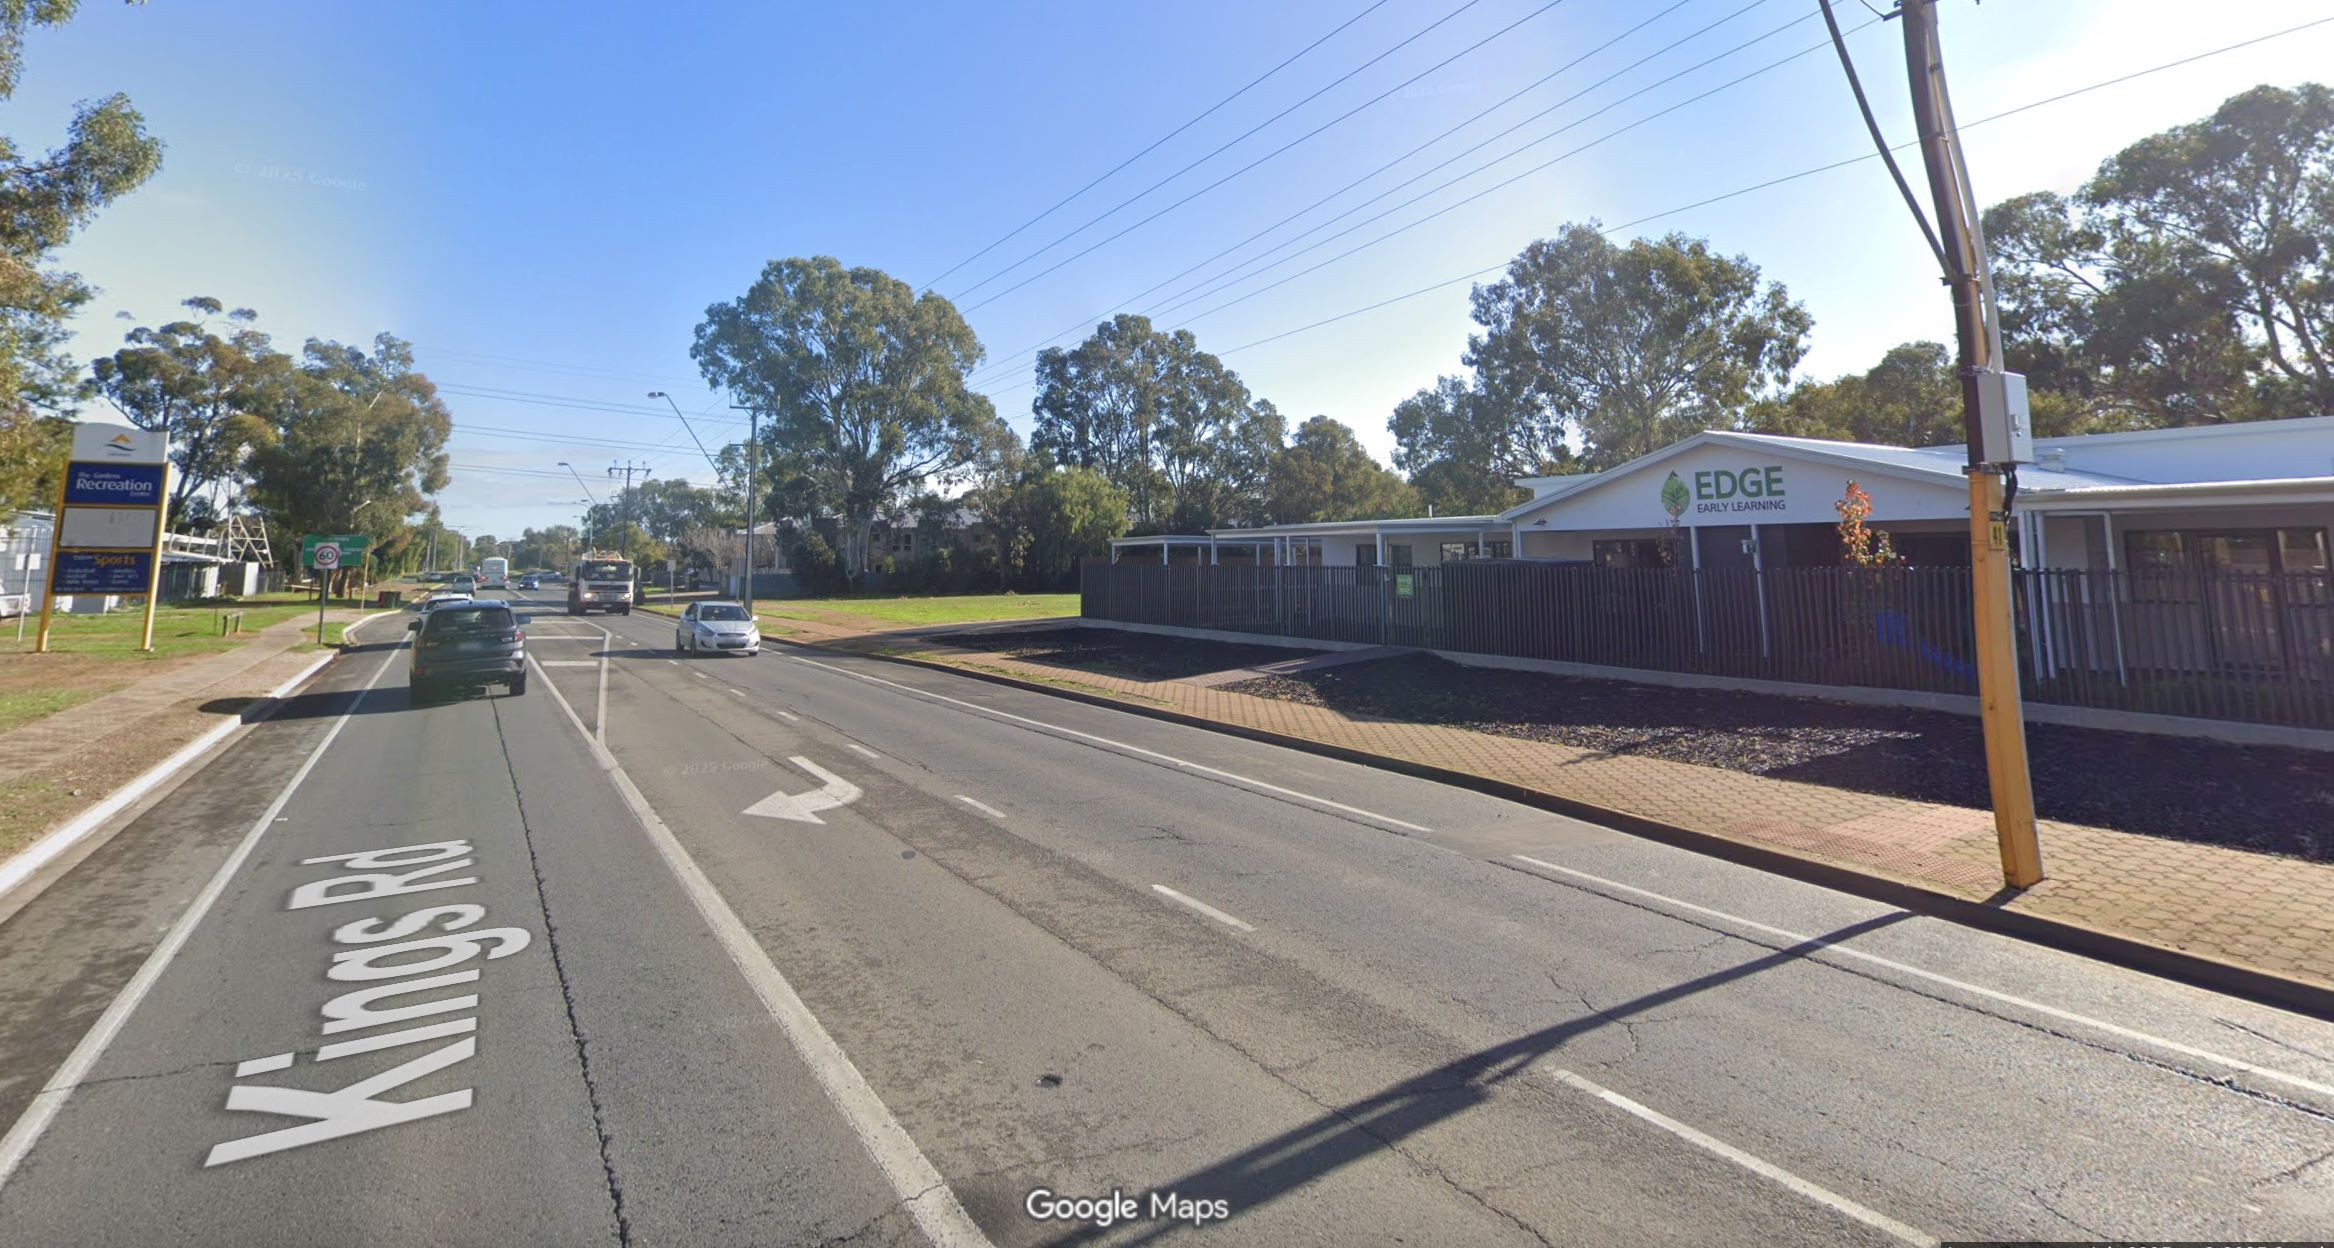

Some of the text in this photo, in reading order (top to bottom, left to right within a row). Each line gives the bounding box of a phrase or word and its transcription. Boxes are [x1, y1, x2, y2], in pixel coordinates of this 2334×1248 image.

[76, 479, 153, 492] Recreation
[1694, 466, 1786, 501] EDGE
[1697, 499, 1786, 513] EARLY LEARNING
[319, 551, 334, 560] 60
